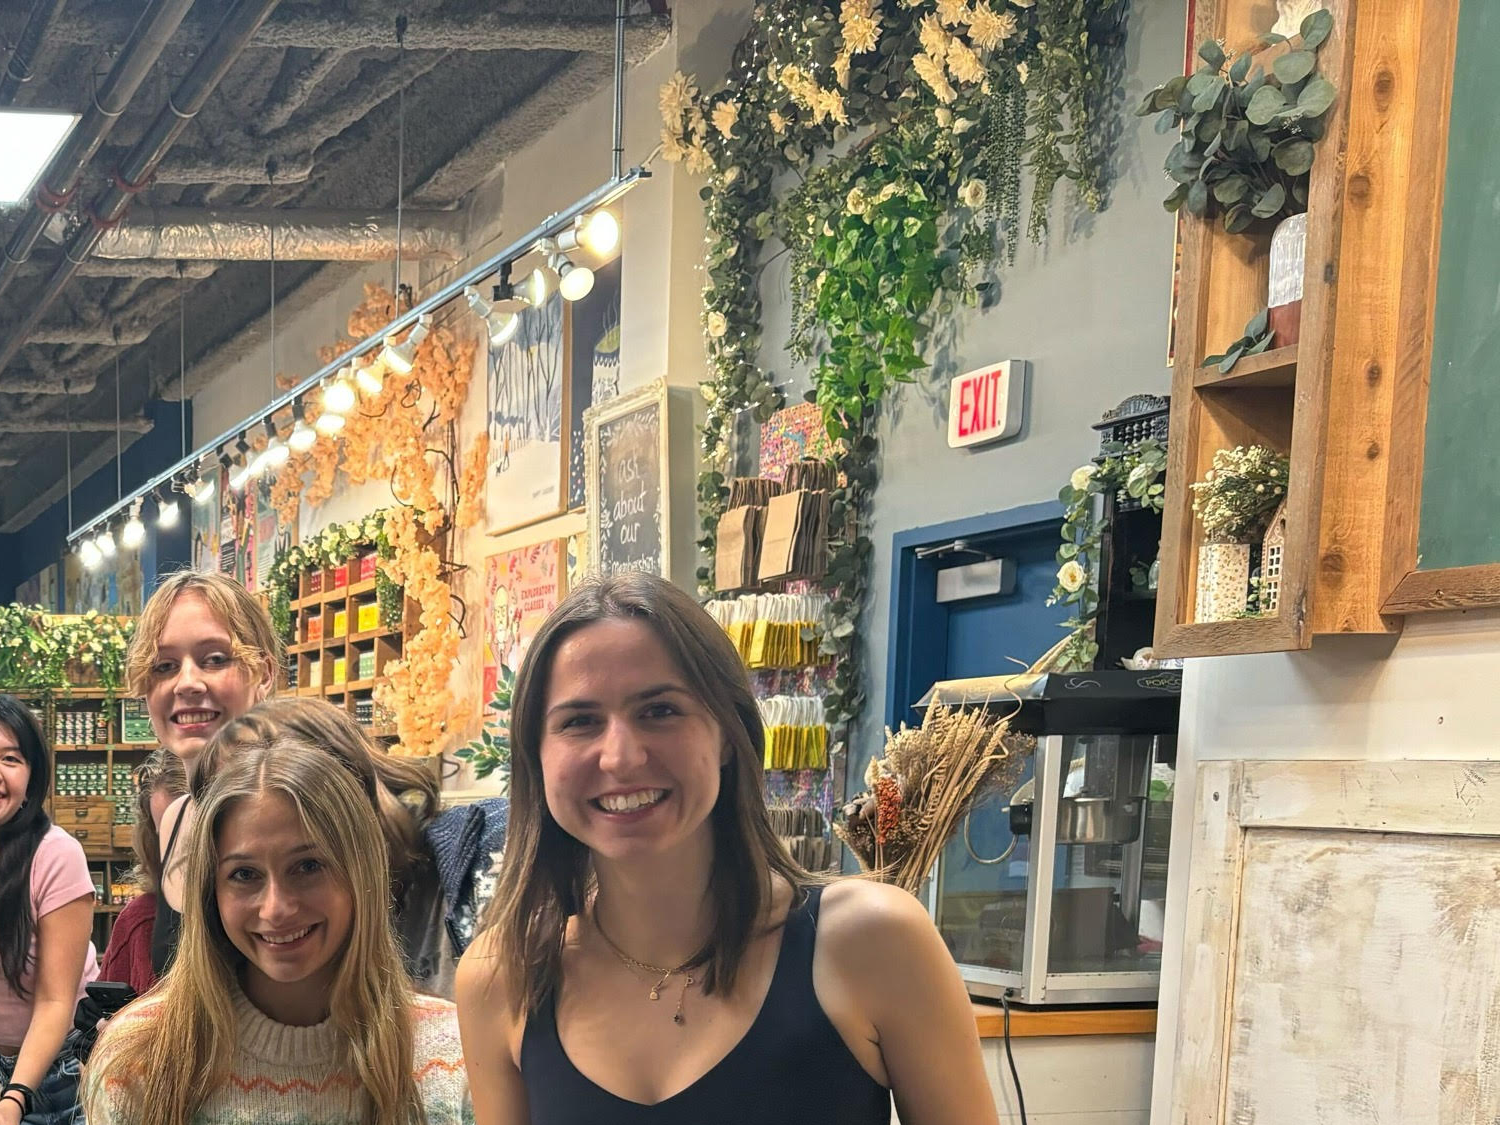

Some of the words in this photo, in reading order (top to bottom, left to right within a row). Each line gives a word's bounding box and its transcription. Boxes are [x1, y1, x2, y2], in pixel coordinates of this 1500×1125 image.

[958, 370, 1002, 437] EXIT
[618, 453, 641, 483] ask
[613, 480, 648, 522] about
[619, 523, 641, 545] our
